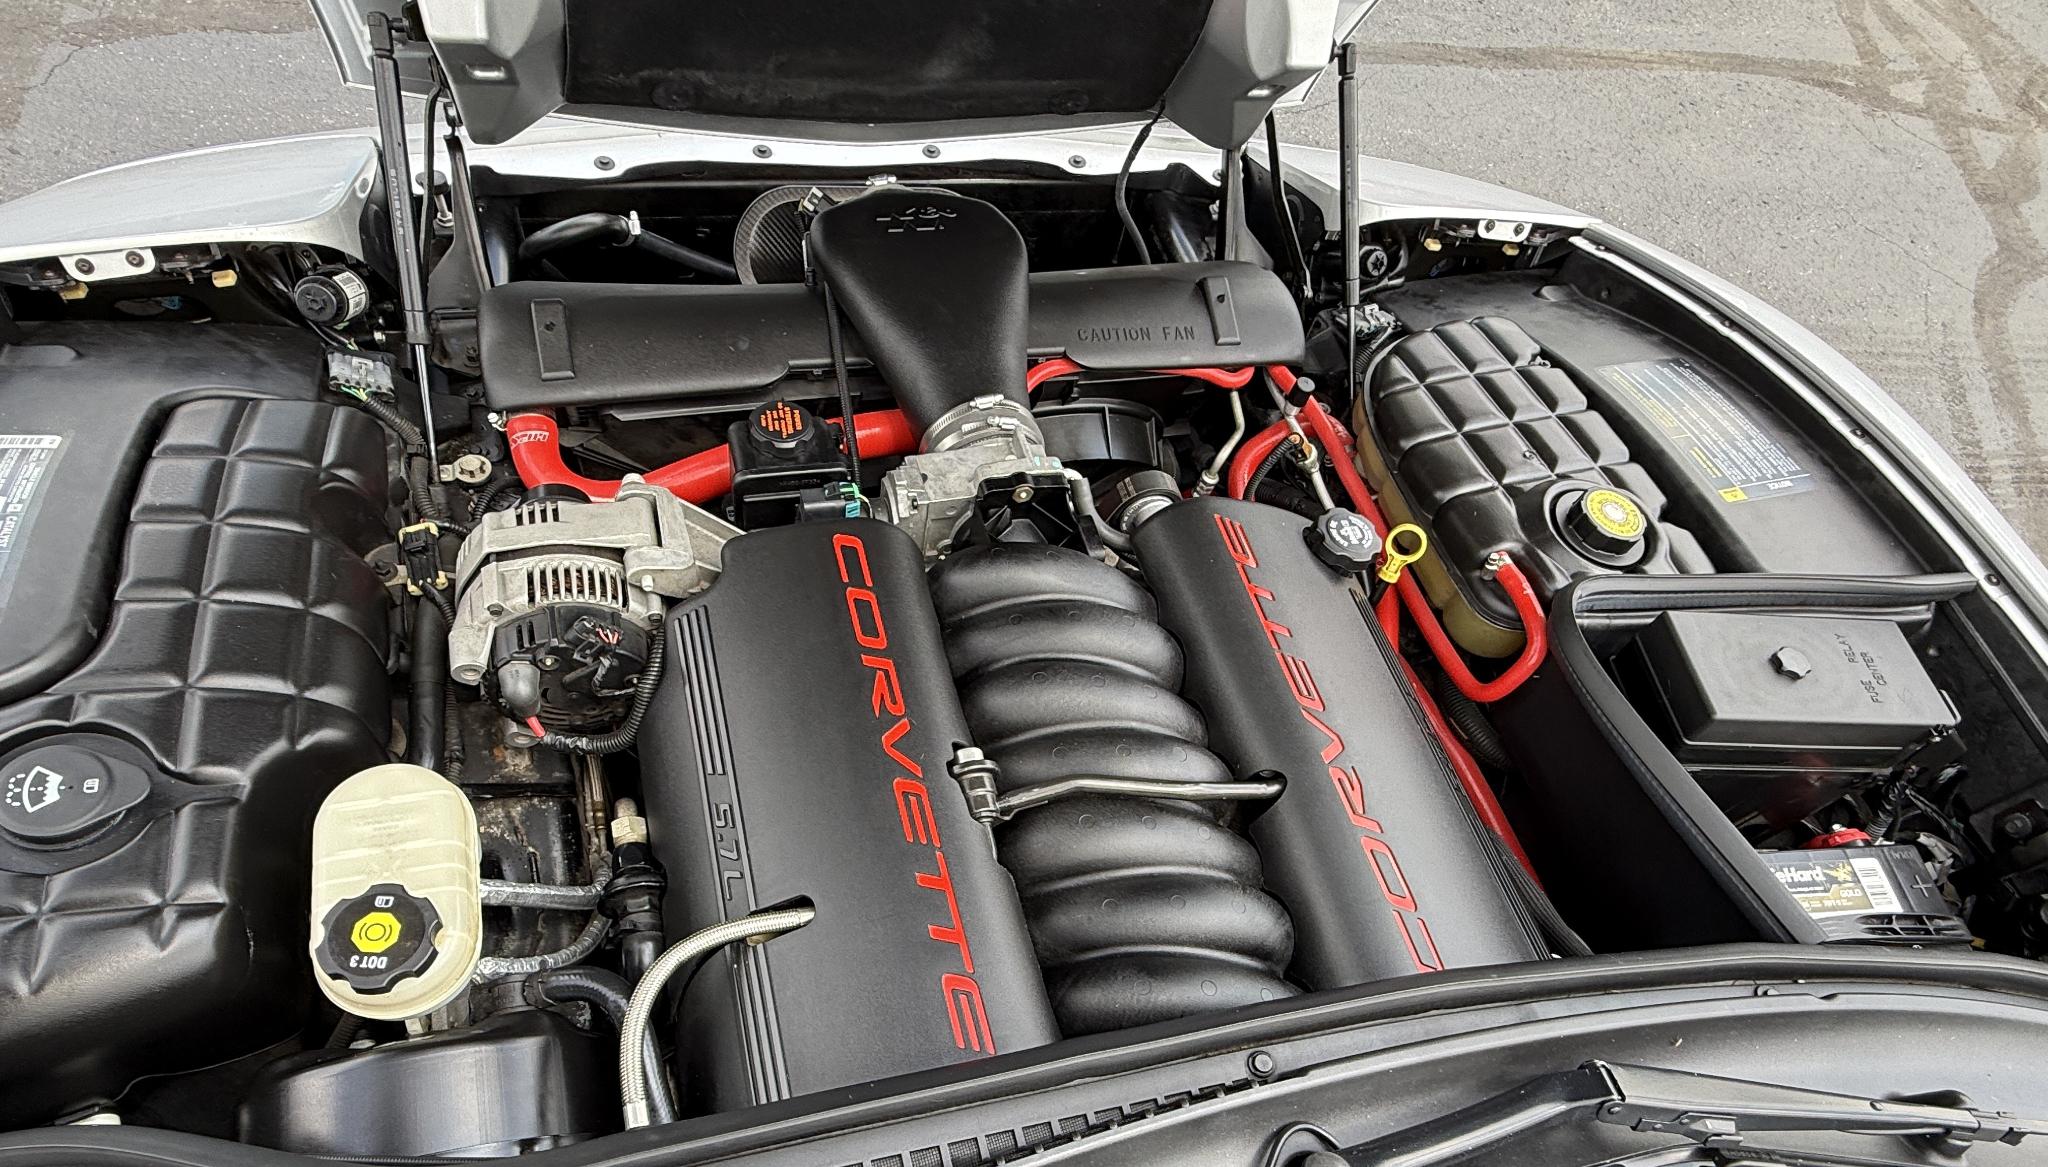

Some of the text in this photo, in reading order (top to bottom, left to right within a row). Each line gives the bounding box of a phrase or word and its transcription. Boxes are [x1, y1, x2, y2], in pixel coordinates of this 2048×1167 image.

[1077, 325, 1196, 342] CAUTION FAN
[1834, 633, 1884, 704] FUSE RELAY
[1860, 651, 1888, 686] CENTER
[1214, 513, 1446, 974] CORVETTE
[831, 532, 996, 1056] CORVETTE
[713, 802, 743, 902] 5.7L
[1771, 866, 1826, 882] eHard
[1840, 889, 1862, 897] GOLD
[348, 955, 388, 970] DOT 3
